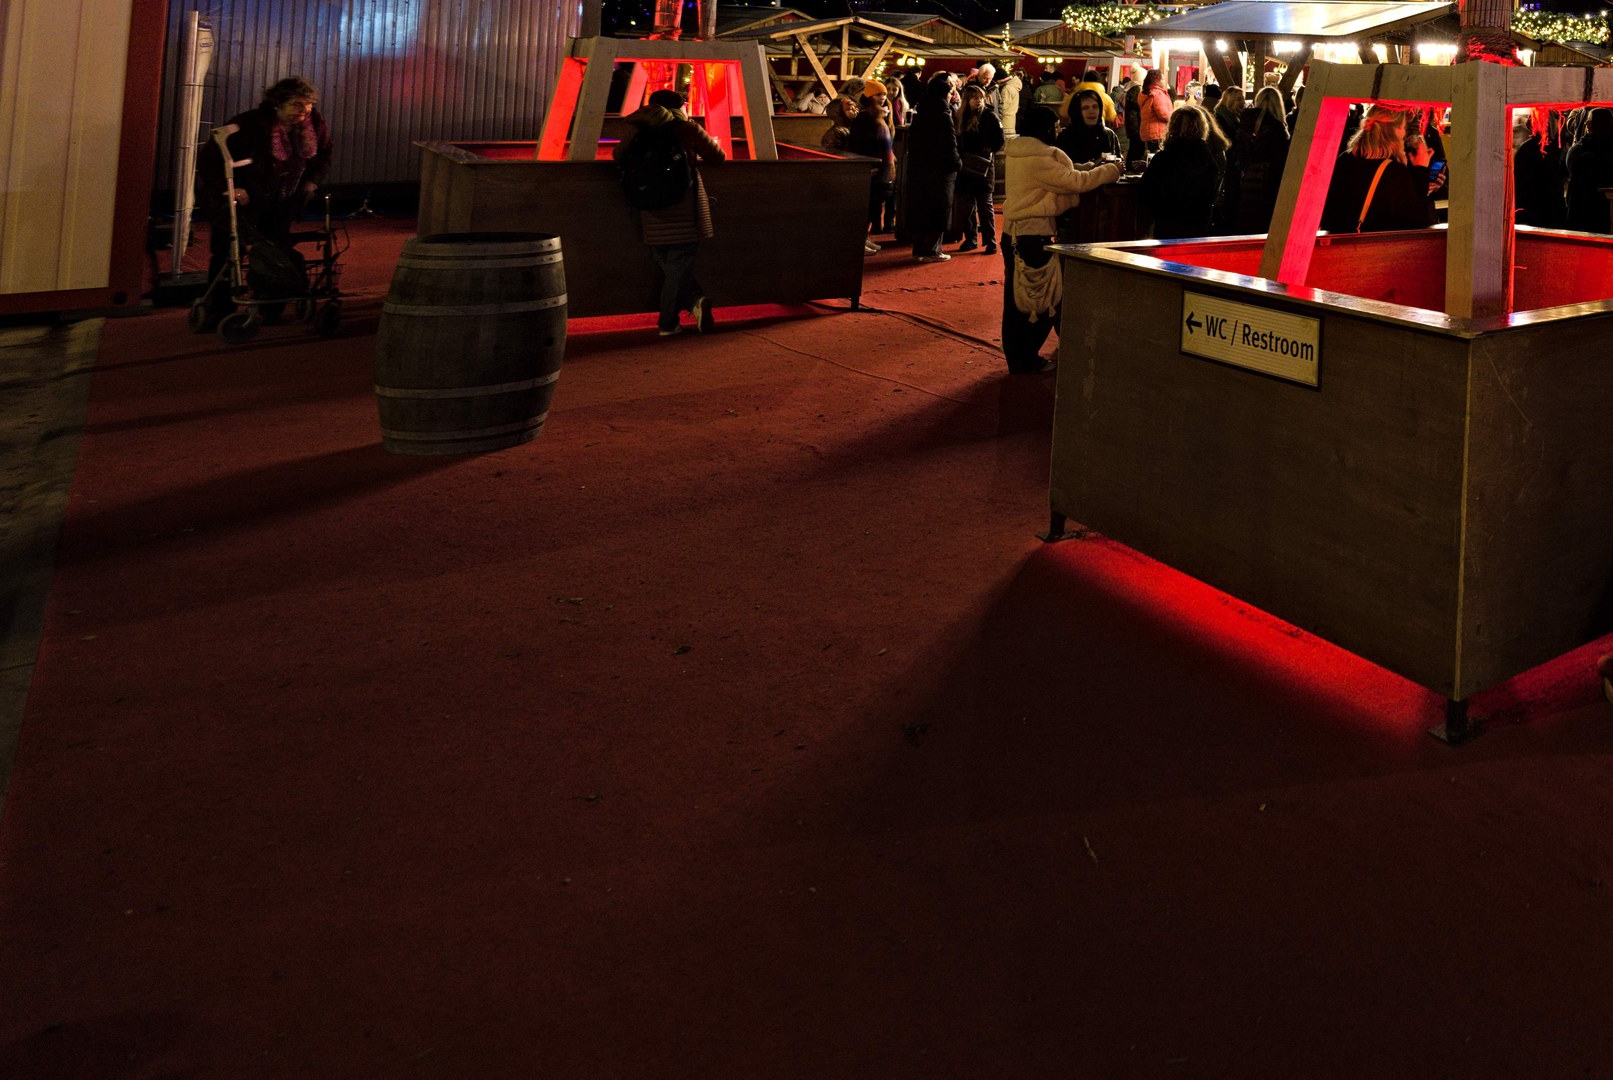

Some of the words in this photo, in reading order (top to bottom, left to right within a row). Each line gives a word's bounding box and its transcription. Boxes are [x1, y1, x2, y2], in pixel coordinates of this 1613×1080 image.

[1205, 314, 1227, 340] WC
[1230, 319, 1238, 346] /
[1242, 323, 1314, 361] Restroom
